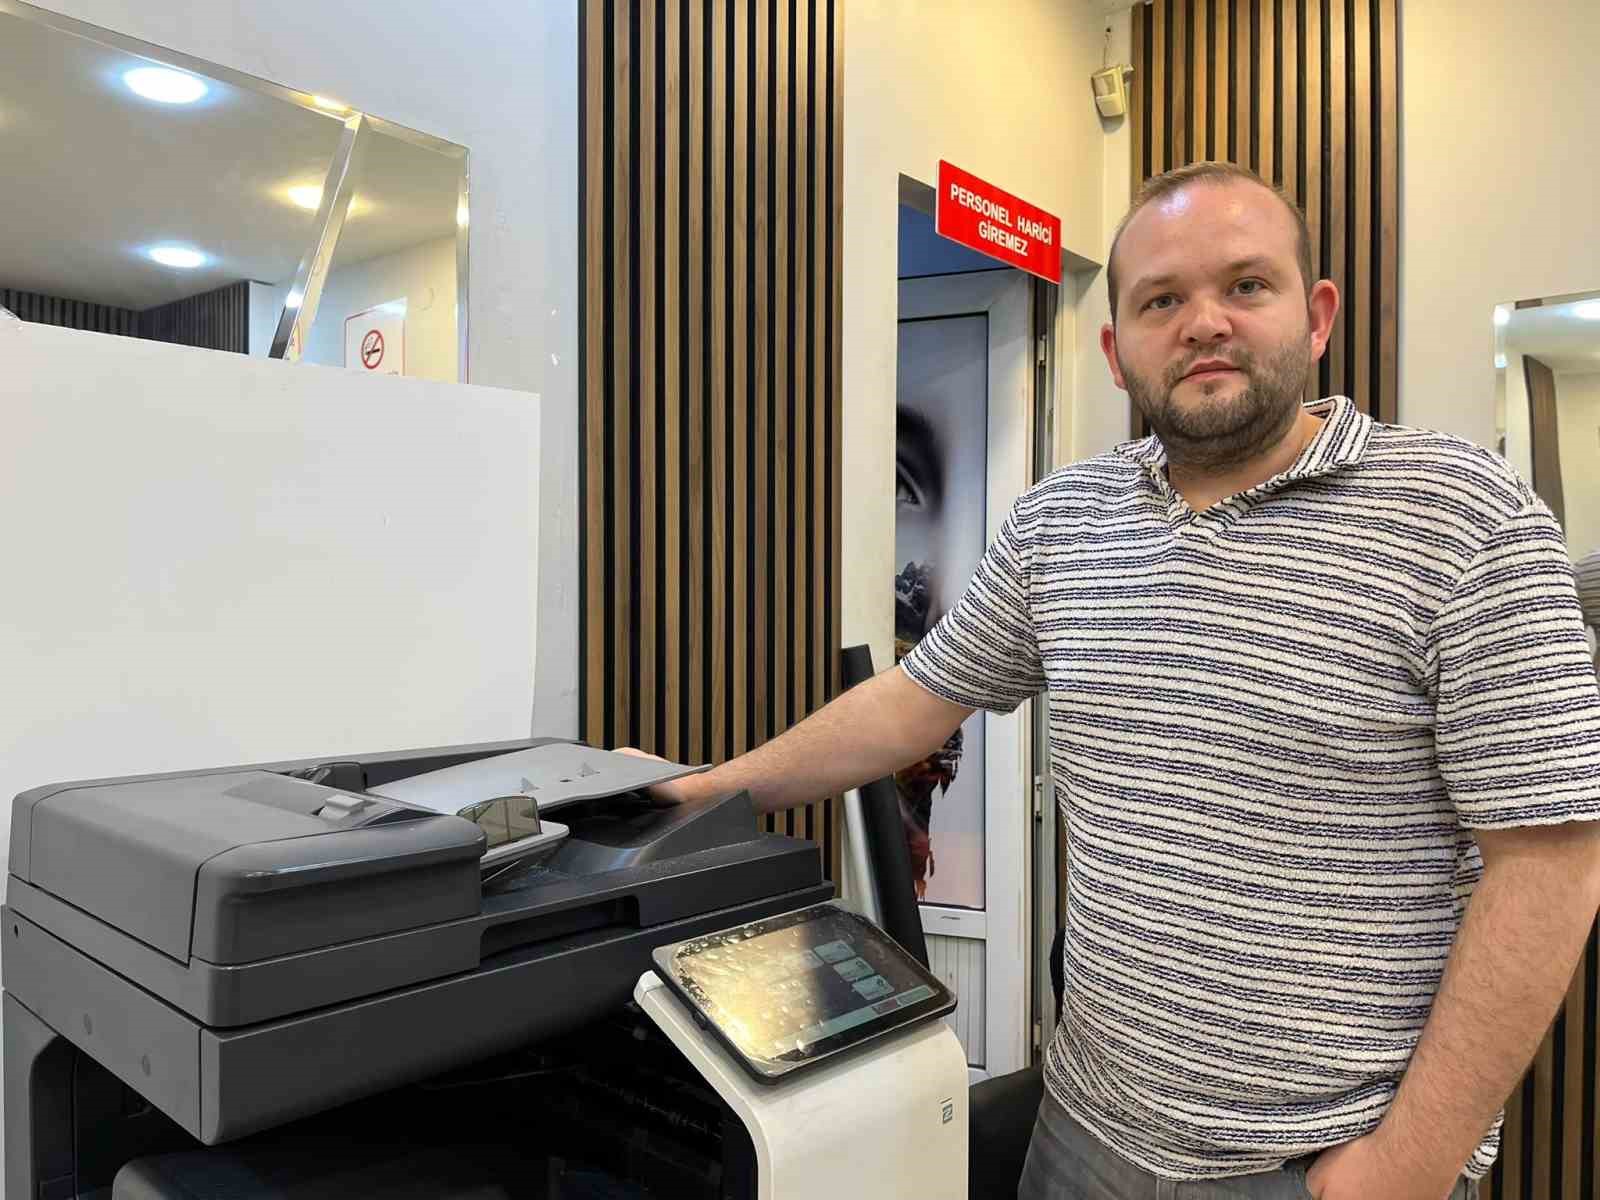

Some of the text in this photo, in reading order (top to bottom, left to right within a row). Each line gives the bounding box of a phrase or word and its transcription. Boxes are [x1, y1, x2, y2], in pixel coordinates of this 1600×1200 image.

[950, 183, 1052, 245] PERSONEL HARİCİ
[978, 220, 1028, 256] GİREMEZ
